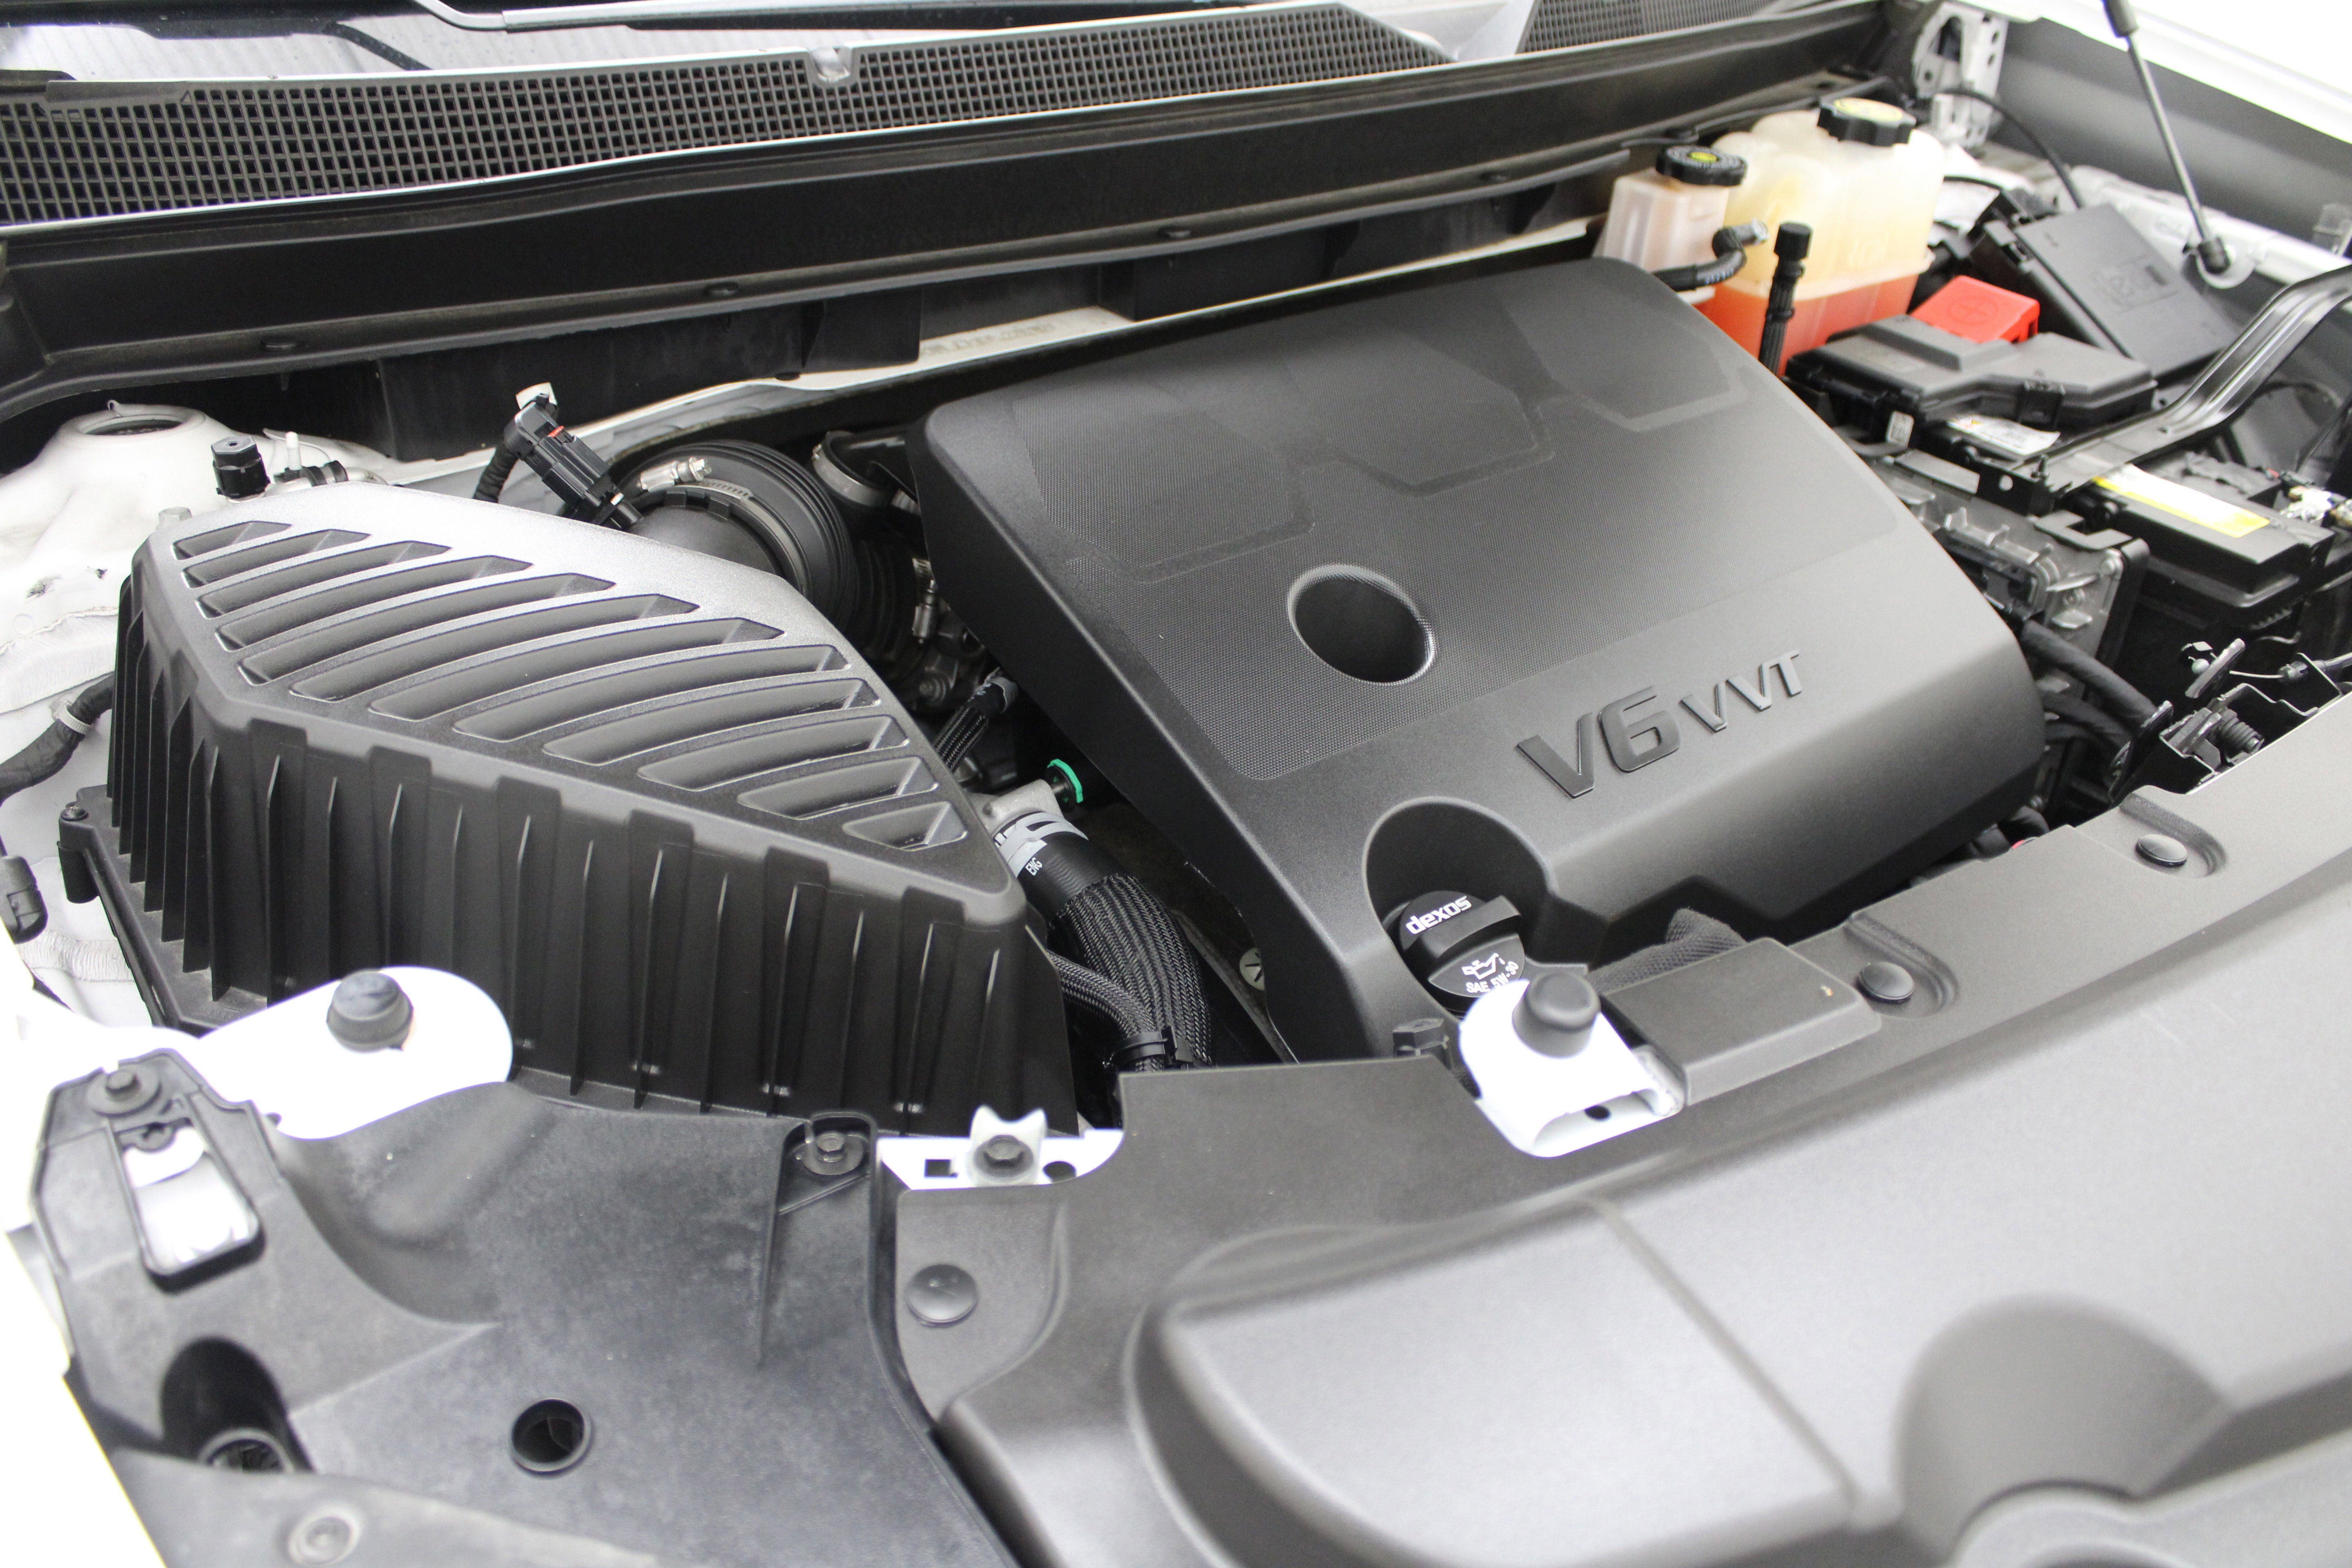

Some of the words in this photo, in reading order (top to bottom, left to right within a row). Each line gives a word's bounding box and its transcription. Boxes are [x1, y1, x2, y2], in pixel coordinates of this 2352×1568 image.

[1516, 685, 1681, 799] V6
[1679, 650, 1802, 733] VVT
[1025, 857, 1042, 876] ENG
[1405, 895, 1472, 935] dexos
[1466, 981, 1491, 993] SAE
[1490, 961, 1519, 989] 5W-30
